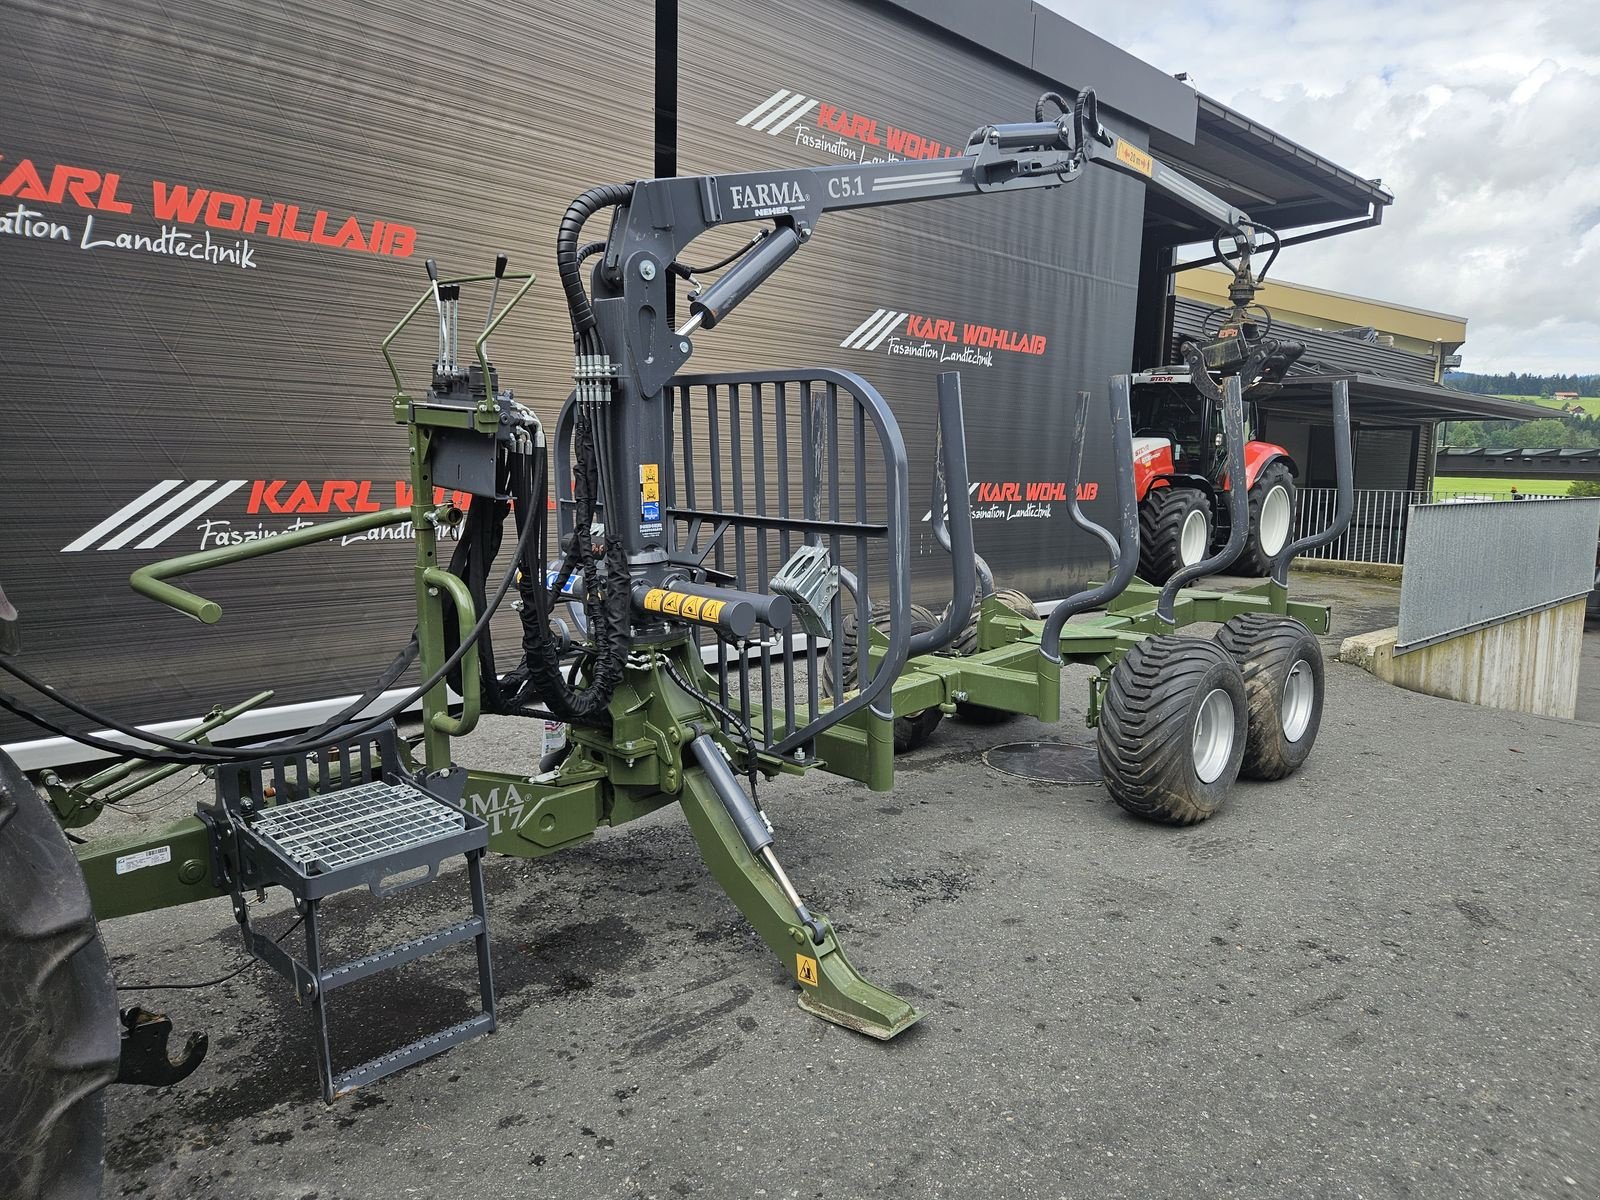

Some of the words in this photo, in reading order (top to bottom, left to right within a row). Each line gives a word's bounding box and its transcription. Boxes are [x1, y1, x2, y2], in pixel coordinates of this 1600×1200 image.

[817, 103, 881, 145] KARL
[795, 123, 857, 160] Faszination
[828, 175, 865, 198] C5.1
[0, 155, 133, 215] ARL
[152, 180, 417, 258] WOHLLAIB
[754, 206, 790, 217] NEHER
[80, 214, 256, 268] Landtechnik
[887, 336, 939, 358] Faszination
[940, 343, 993, 367] Landtechnik
[906, 314, 958, 343] KARL
[963, 323, 1047, 355] WOHLLAIB
[246, 480, 382, 514] KARL
[977, 482, 1023, 502] KARL
[1025, 482, 1099, 502] WOHLAIB
[970, 503, 1006, 520] szination
[1006, 502, 1052, 521] Landtechnik
